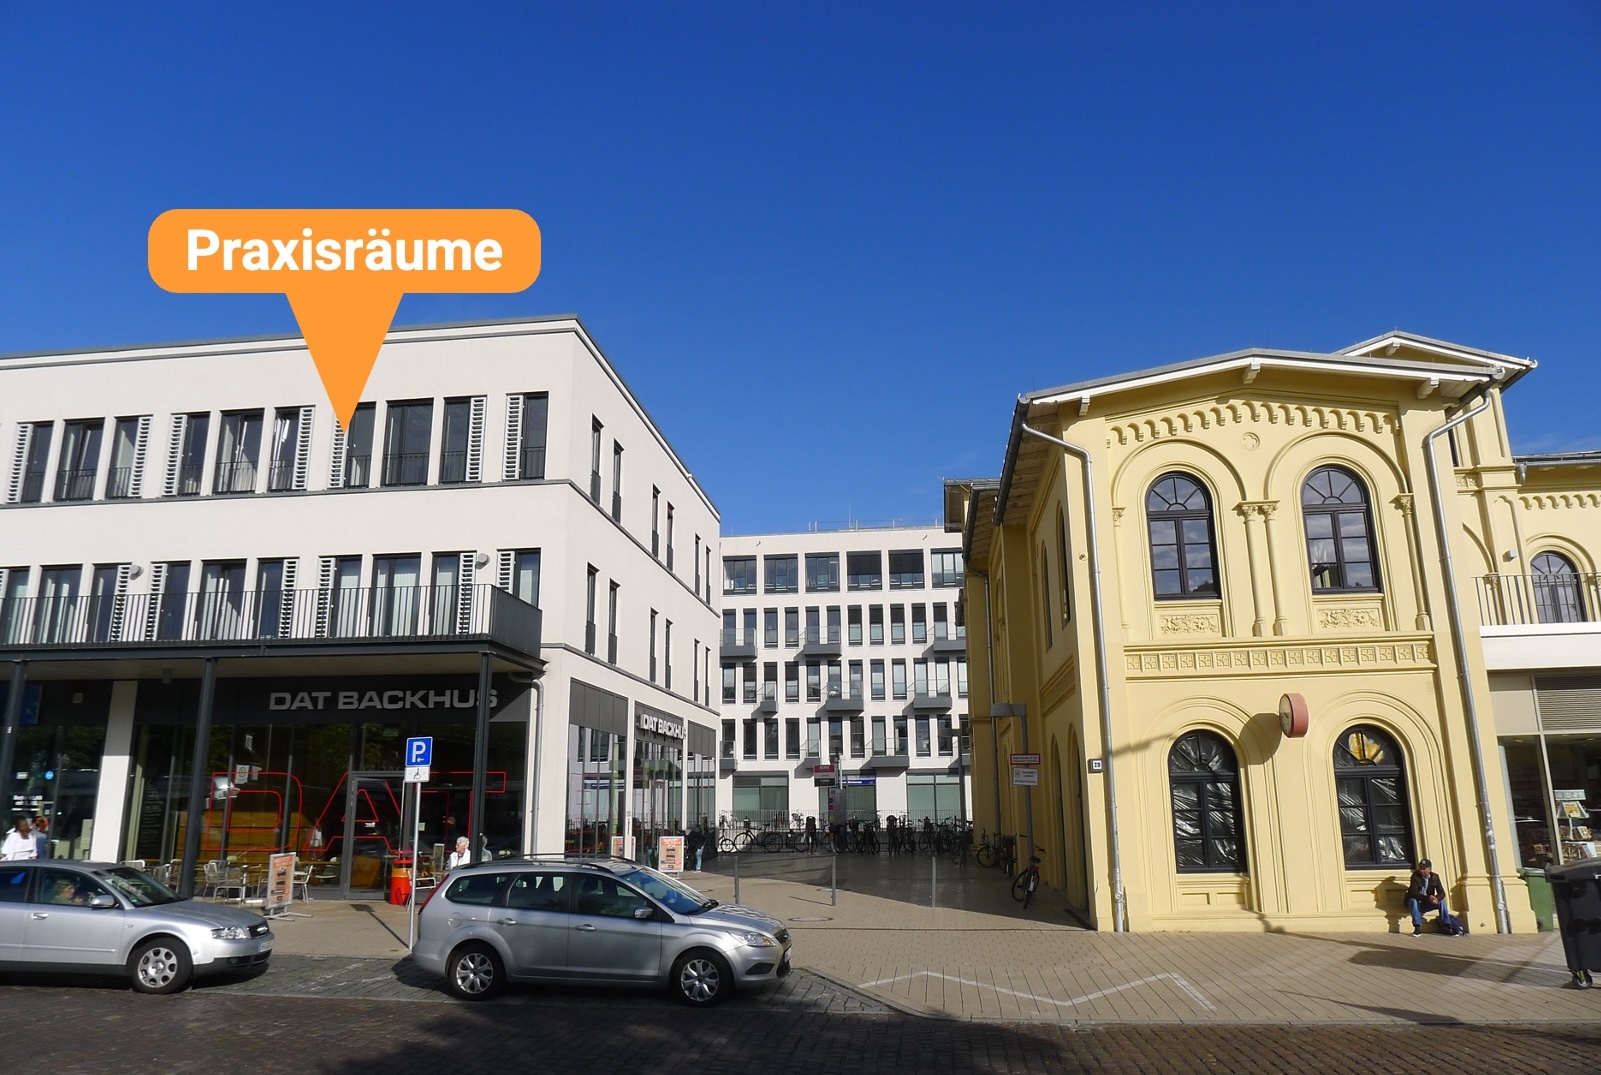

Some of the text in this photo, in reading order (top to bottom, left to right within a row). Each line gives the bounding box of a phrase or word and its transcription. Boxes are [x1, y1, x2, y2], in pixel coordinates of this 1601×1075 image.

[269, 692, 331, 710] DAT
[641, 714, 658, 731] DAT
[412, 742, 426, 763] P
